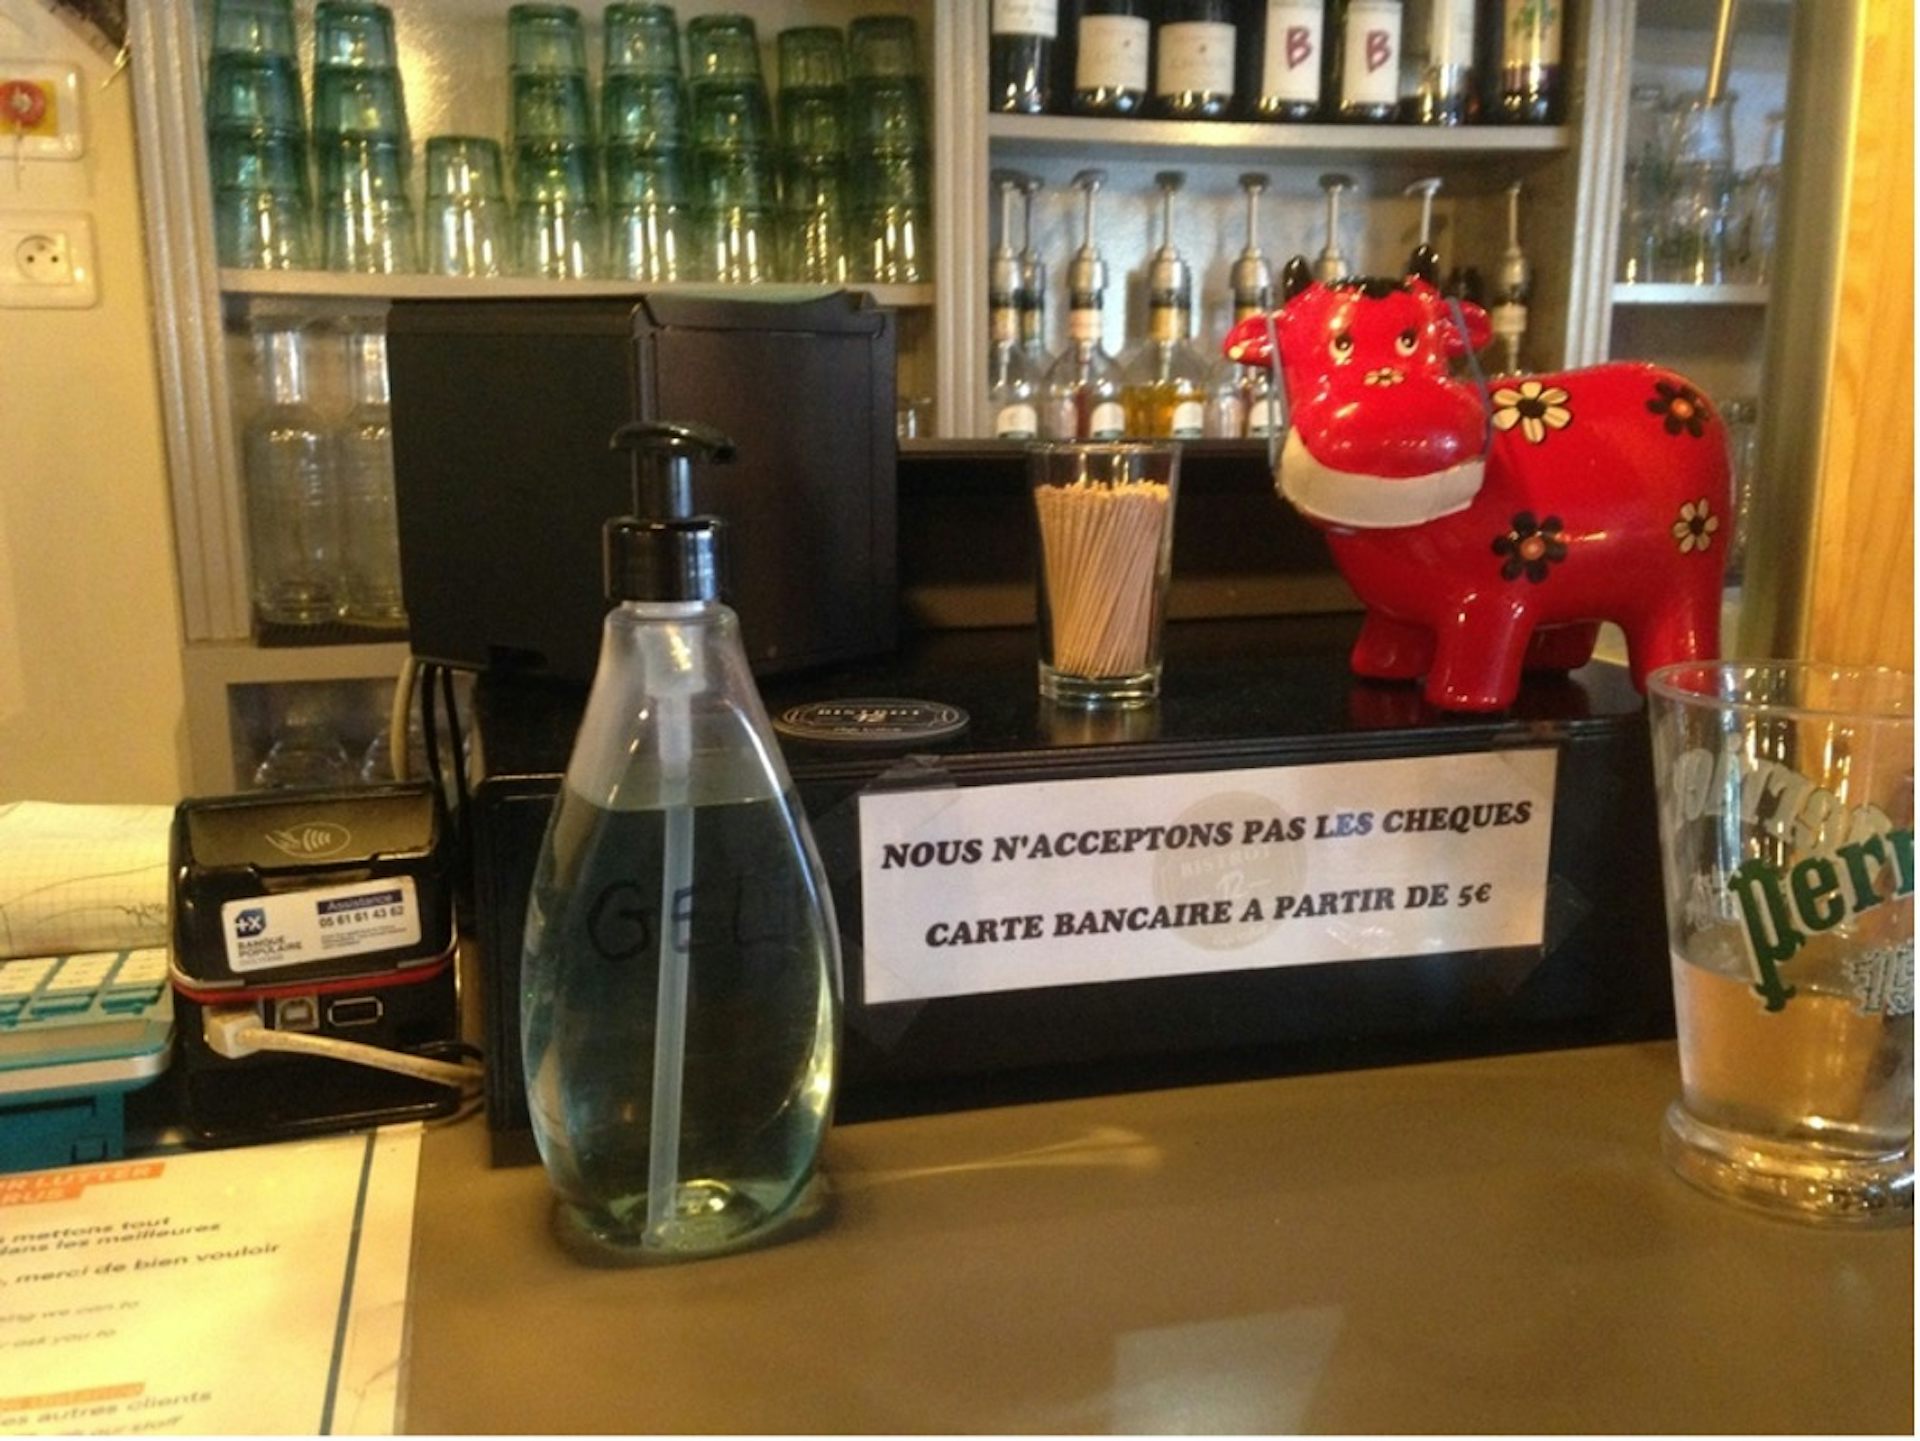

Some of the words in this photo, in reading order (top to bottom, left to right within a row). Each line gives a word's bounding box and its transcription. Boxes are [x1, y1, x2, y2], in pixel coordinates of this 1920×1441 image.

[1286, 26, 1312, 69] B
[1366, 31, 1391, 73] B
[878, 838, 983, 869] NOUS
[991, 821, 1234, 862] N'ACCEPTONS
[1241, 816, 1306, 845] PAS
[1314, 812, 1374, 839] LES
[1382, 801, 1533, 834] CHEQUES
[587, 877, 789, 960] GEL
[925, 915, 1044, 948] CARTE
[1053, 900, 1233, 937] BANCAIRE
[1239, 898, 1264, 922] A
[1273, 887, 1395, 920] PARTIR
[1404, 884, 1449, 909] DE
[1458, 883, 1492, 908] 5€
[13, 1223, 113, 1243] mettons
[122, 1216, 170, 1230] tout
[56, 1238, 90, 1250] les
[97, 1222, 221, 1245] meilleures
[15, 1266, 88, 1284] merci
[94, 1261, 126, 1275] de
[133, 1256, 189, 1271] bien
[196, 1243, 281, 1262] vouloir
[37, 1404, 118, 1424] autres
[126, 1390, 213, 1413] clients
